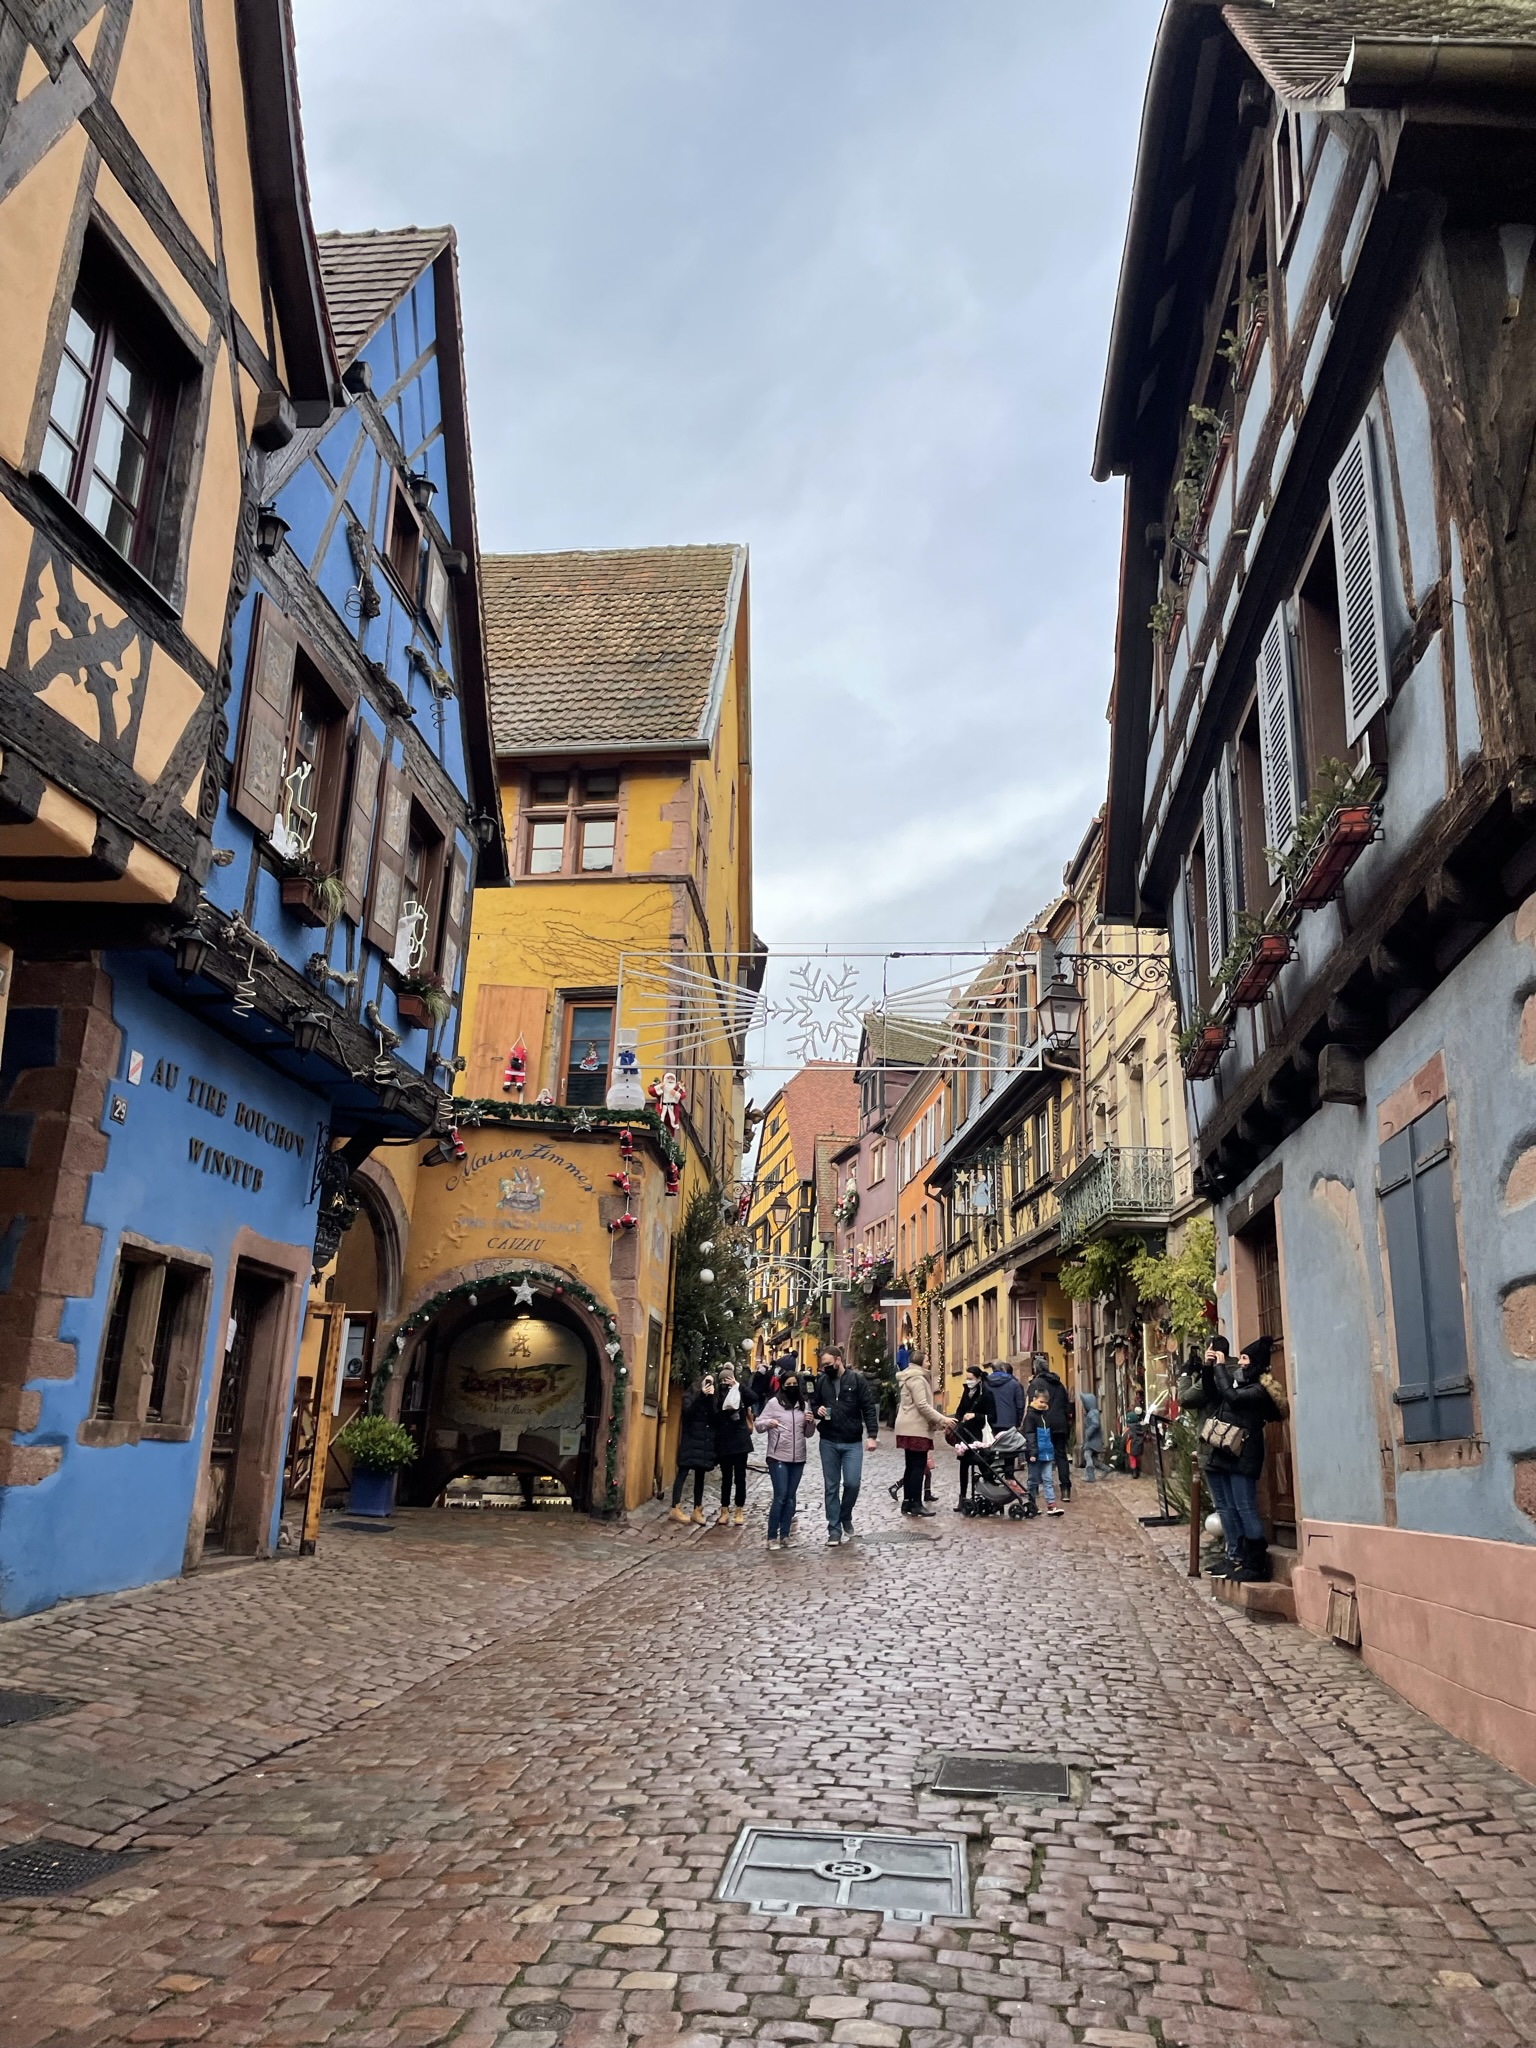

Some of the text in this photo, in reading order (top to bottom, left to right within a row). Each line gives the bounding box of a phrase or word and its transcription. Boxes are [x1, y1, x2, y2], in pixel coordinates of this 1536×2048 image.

[152, 1056, 181, 1092] AU
[187, 1075, 229, 1118] TIRE
[234, 1101, 306, 1160] BOUCHON
[188, 1136, 264, 1193] WINSTUB
[446, 1143, 596, 1194] Maison Zimmer
[487, 1237, 546, 1251] CAVEAU
